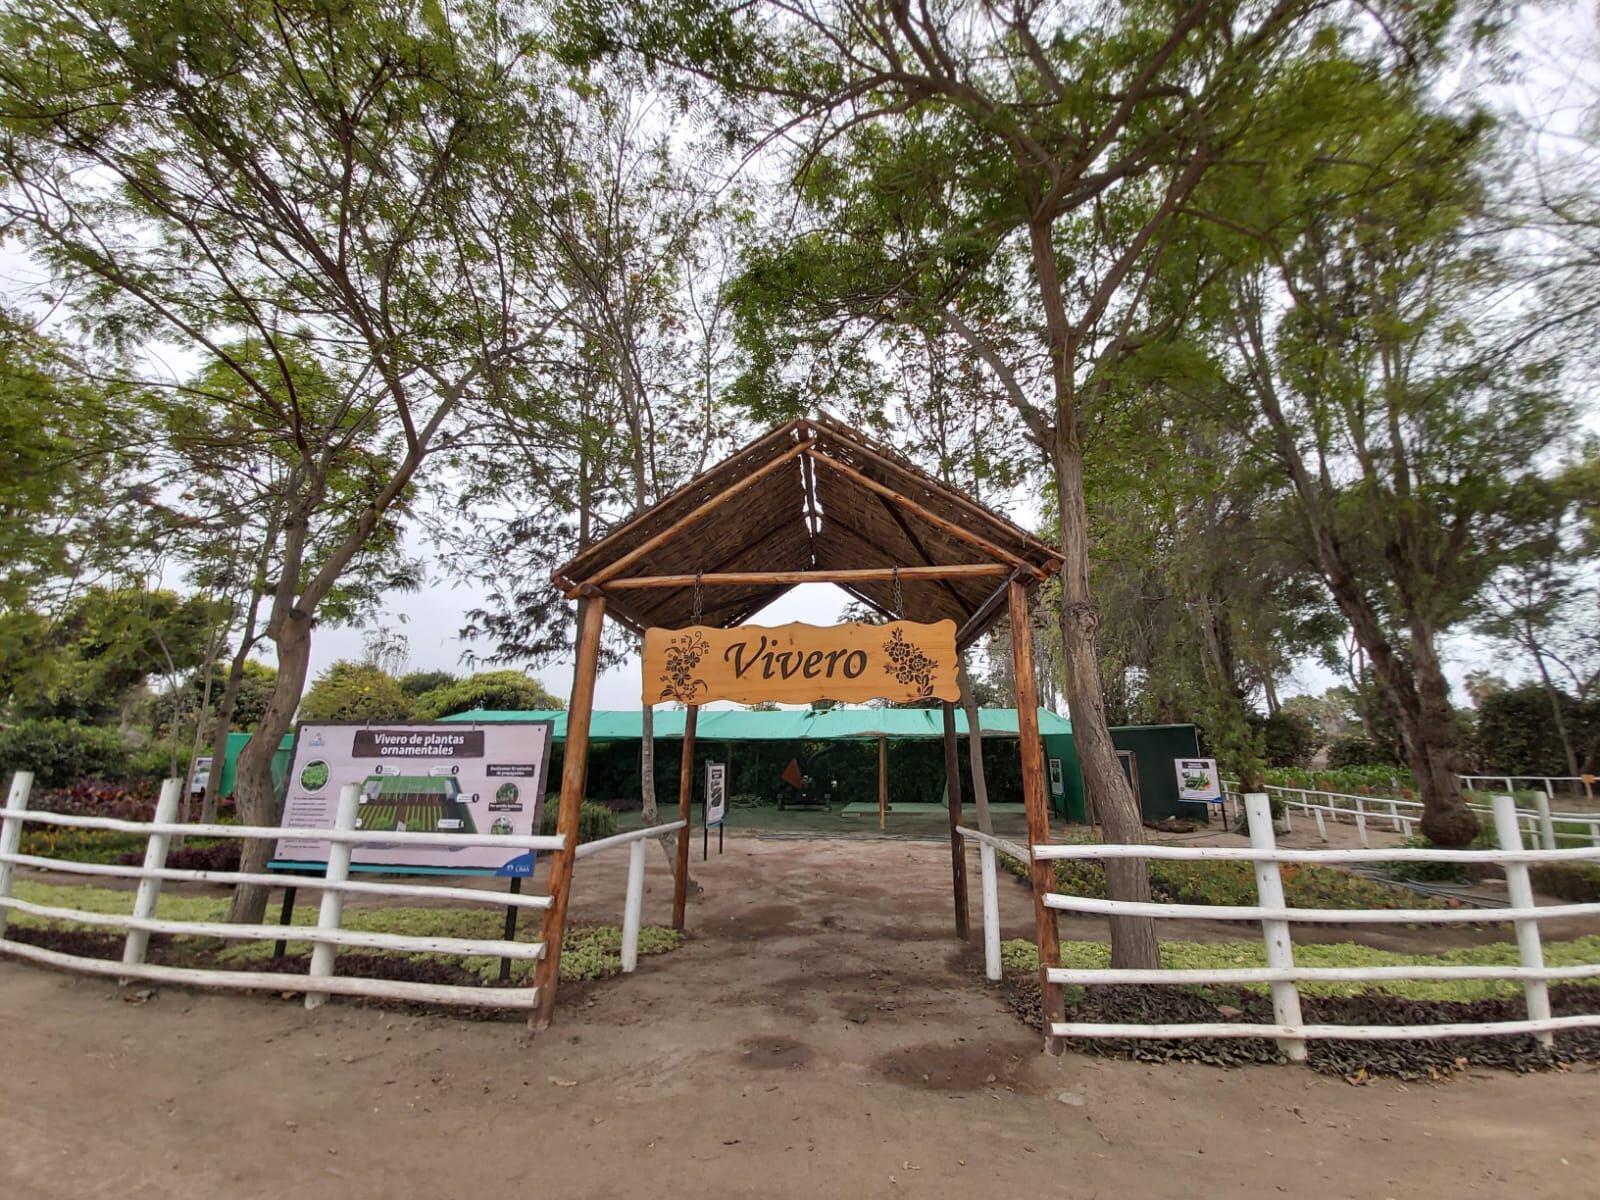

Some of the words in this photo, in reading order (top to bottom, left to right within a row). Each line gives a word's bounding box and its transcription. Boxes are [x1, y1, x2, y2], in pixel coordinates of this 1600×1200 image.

[724, 635, 868, 681] Vivero
[374, 733, 407, 745] Vivero
[409, 734, 423, 745] de
[424, 734, 465, 747] plantas
[380, 745, 454, 756] ornamentales
